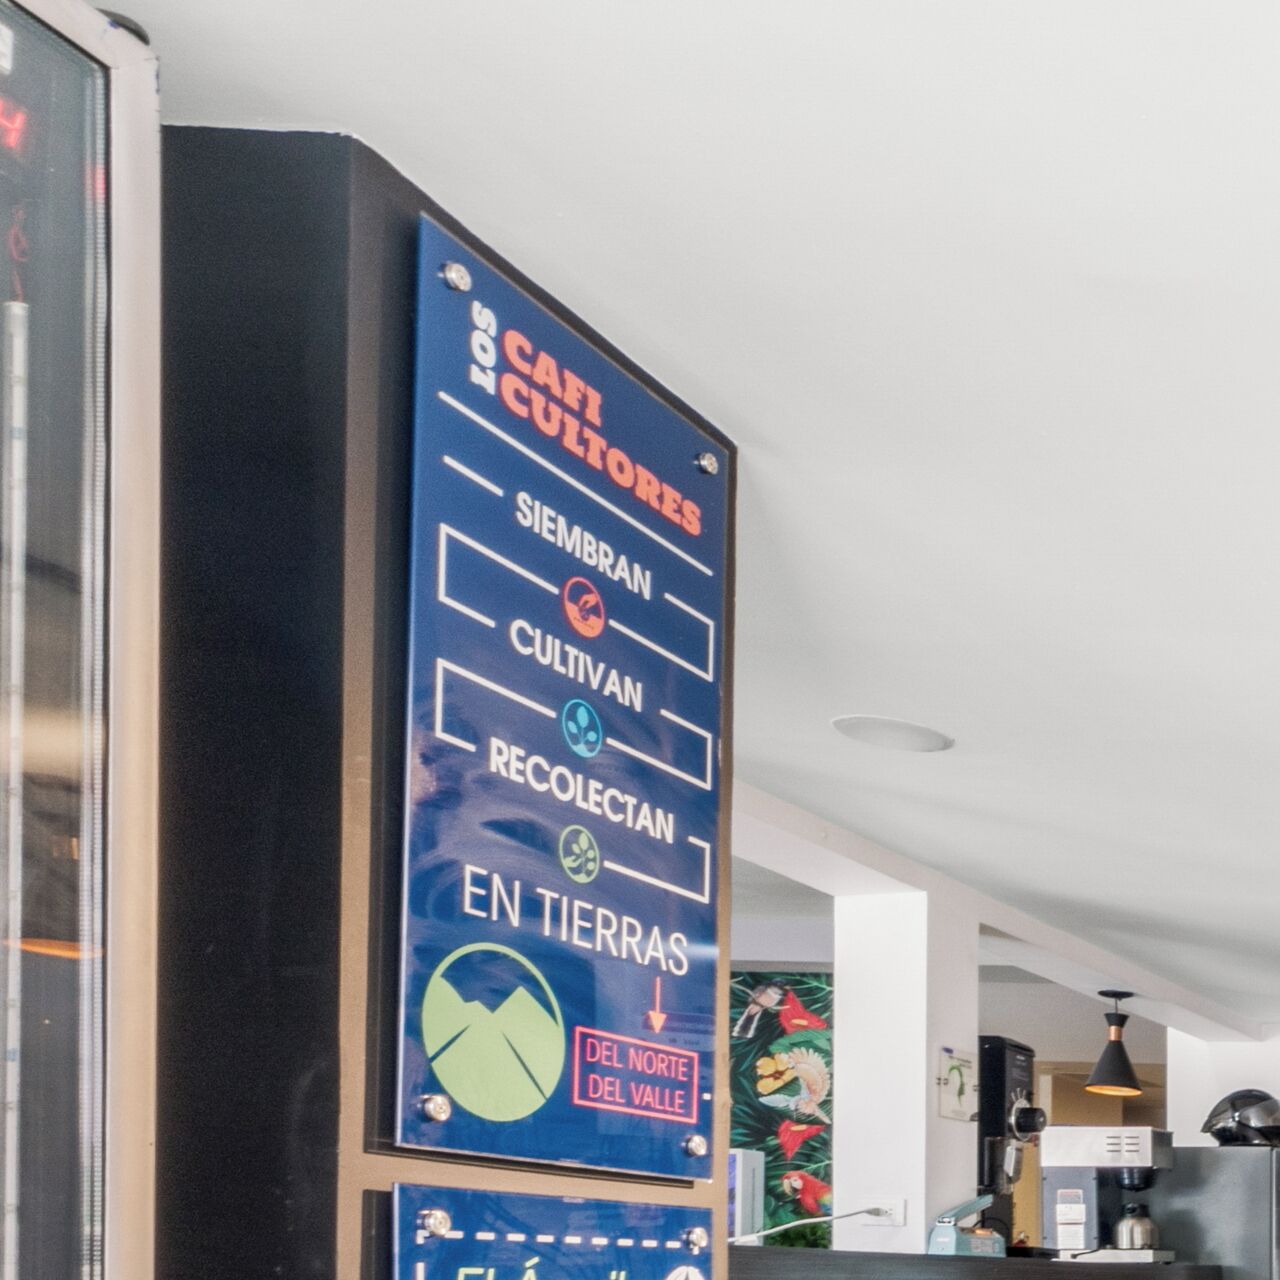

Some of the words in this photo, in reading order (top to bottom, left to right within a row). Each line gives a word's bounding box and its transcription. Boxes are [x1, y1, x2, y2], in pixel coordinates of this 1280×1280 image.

[470, 301, 497, 395] LOS
[502, 329, 603, 427] CAFI
[499, 372, 702, 537] CULTORES
[515, 491, 651, 601] SIEMBRAN
[510, 619, 643, 712] CULTIVAN
[489, 736, 674, 844] RECOLECTAN
[463, 864, 521, 928] EN
[536, 886, 690, 977] TIERRAS
[585, 1037, 623, 1068] DEL
[628, 1048, 689, 1082] NORTE
[588, 1073, 626, 1105] DEL
[629, 1082, 686, 1115] VALLE
